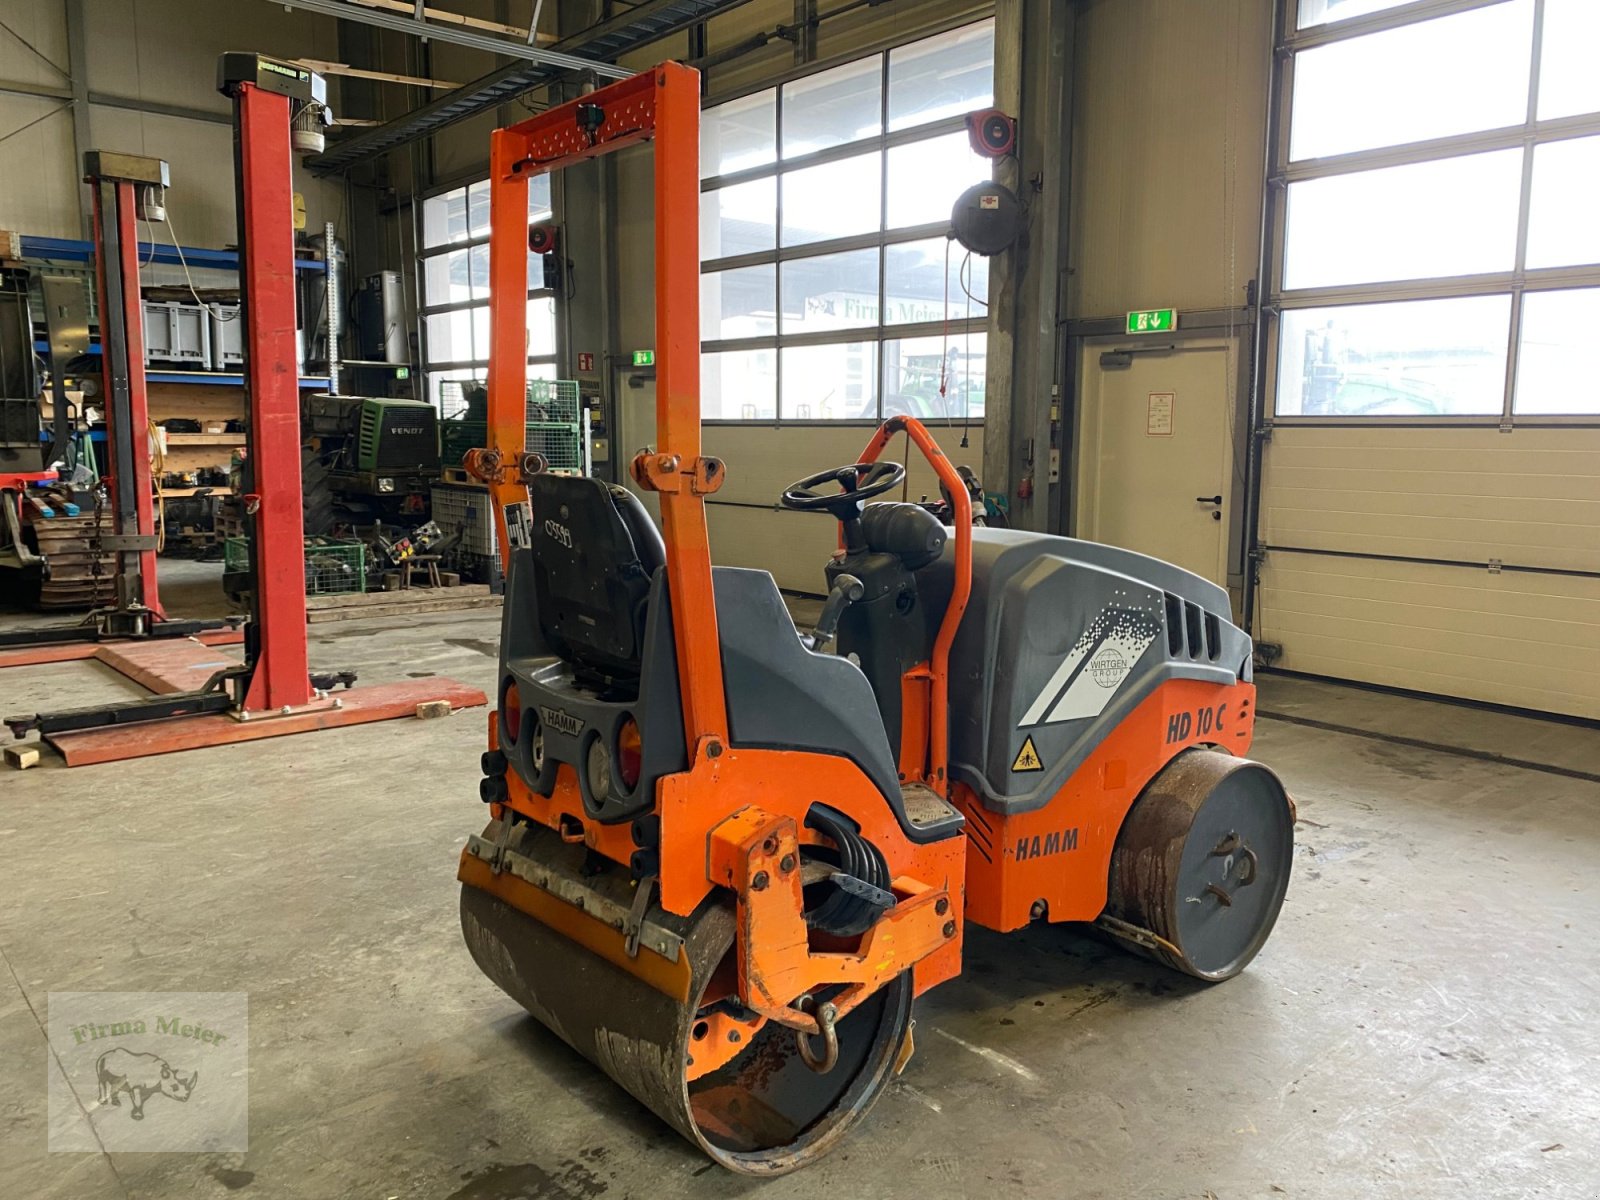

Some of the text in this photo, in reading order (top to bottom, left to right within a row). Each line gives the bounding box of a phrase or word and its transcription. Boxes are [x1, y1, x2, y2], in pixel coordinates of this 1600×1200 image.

[900, 302, 944, 322] Meier
[391, 427, 425, 435] FENDT
[1090, 659, 1128, 669] WIRTGEN
[1092, 669, 1124, 677] GROUP
[547, 710, 577, 735] HAMM
[1166, 703, 1226, 744] HD 10 C
[1016, 828, 1078, 862] HAMM
